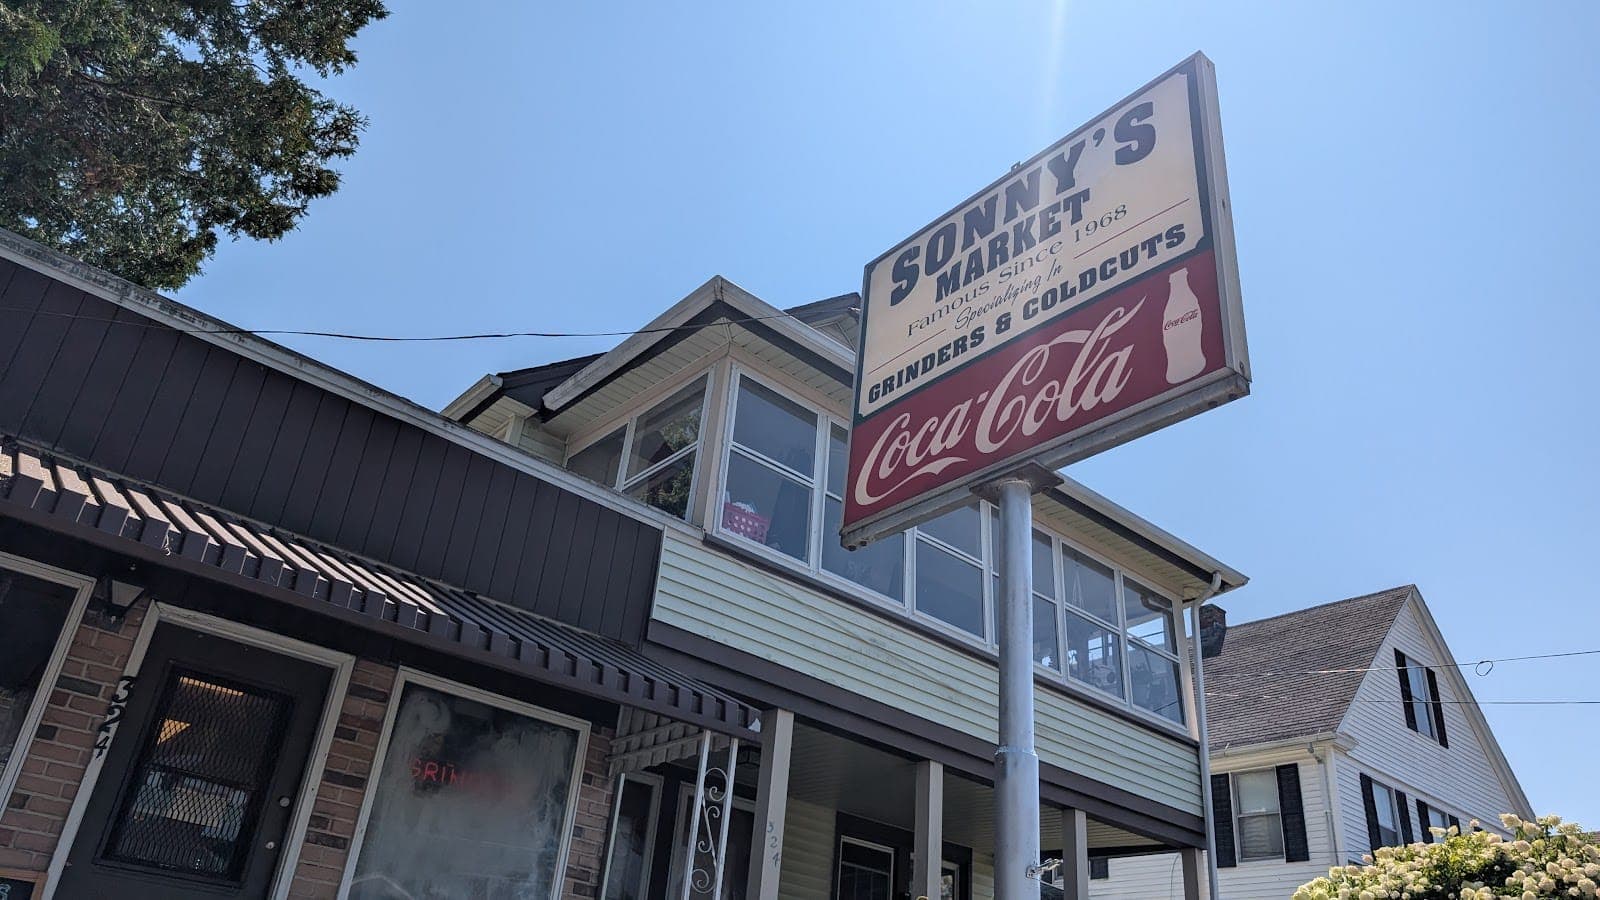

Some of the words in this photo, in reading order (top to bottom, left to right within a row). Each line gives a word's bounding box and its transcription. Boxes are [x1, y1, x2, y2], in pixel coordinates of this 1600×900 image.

[890, 102, 1156, 306] SONNY'S
[935, 188, 1090, 305] MARKET
[868, 325, 985, 404] GRINDERS
[995, 312, 1012, 335] &
[1022, 223, 1186, 321] COLDCUTS
[907, 281, 990, 336] Famous
[998, 241, 1063, 284] Since
[1073, 204, 1128, 243] 1968
[954, 273, 1042, 330] Specializing
[1046, 259, 1063, 282] In
[855, 296, 1146, 506] Coca-Cola
[94, 676, 136, 759] 324
[767, 821, 780, 868] 324
